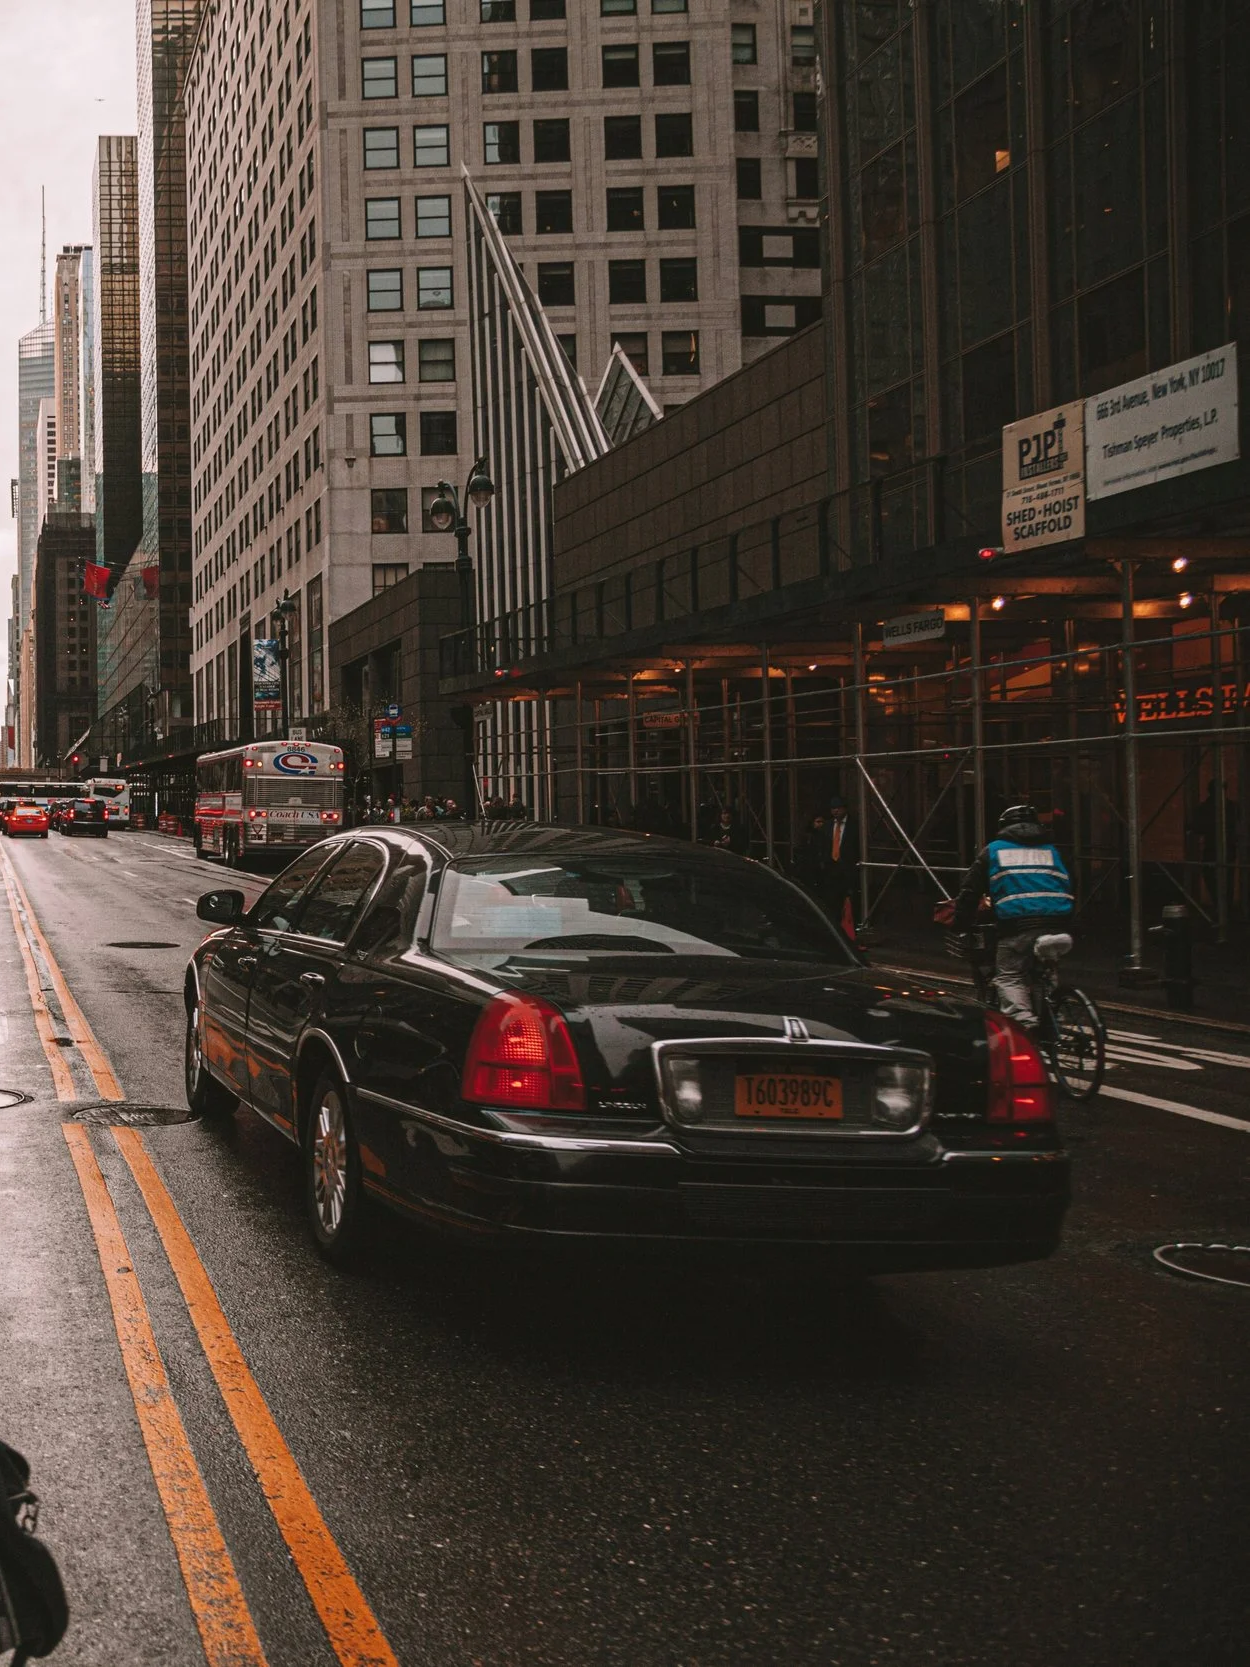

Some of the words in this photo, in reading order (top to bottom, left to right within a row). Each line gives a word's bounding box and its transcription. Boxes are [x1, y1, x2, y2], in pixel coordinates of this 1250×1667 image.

[1110, 396, 1121, 416] 3rd
[1152, 381, 1168, 400] New
[1168, 374, 1187, 394] York,
[1189, 367, 1200, 387] NY
[1201, 358, 1226, 384] 10017
[1102, 440, 1134, 459] Tishman
[1134, 430, 1159, 452] Speyer
[1161, 415, 1203, 441] Properties,
[1006, 508, 1036, 526] SHED
[1043, 496, 1080, 517] HOIST
[1014, 515, 1072, 541] SCAFFOLD
[885, 622, 912, 638] WELLS
[913, 617, 943, 633] FARGO
[269, 810, 299, 819] Coach
[300, 811, 320, 819] USA
[743, 1076, 835, 1108] T603989C
